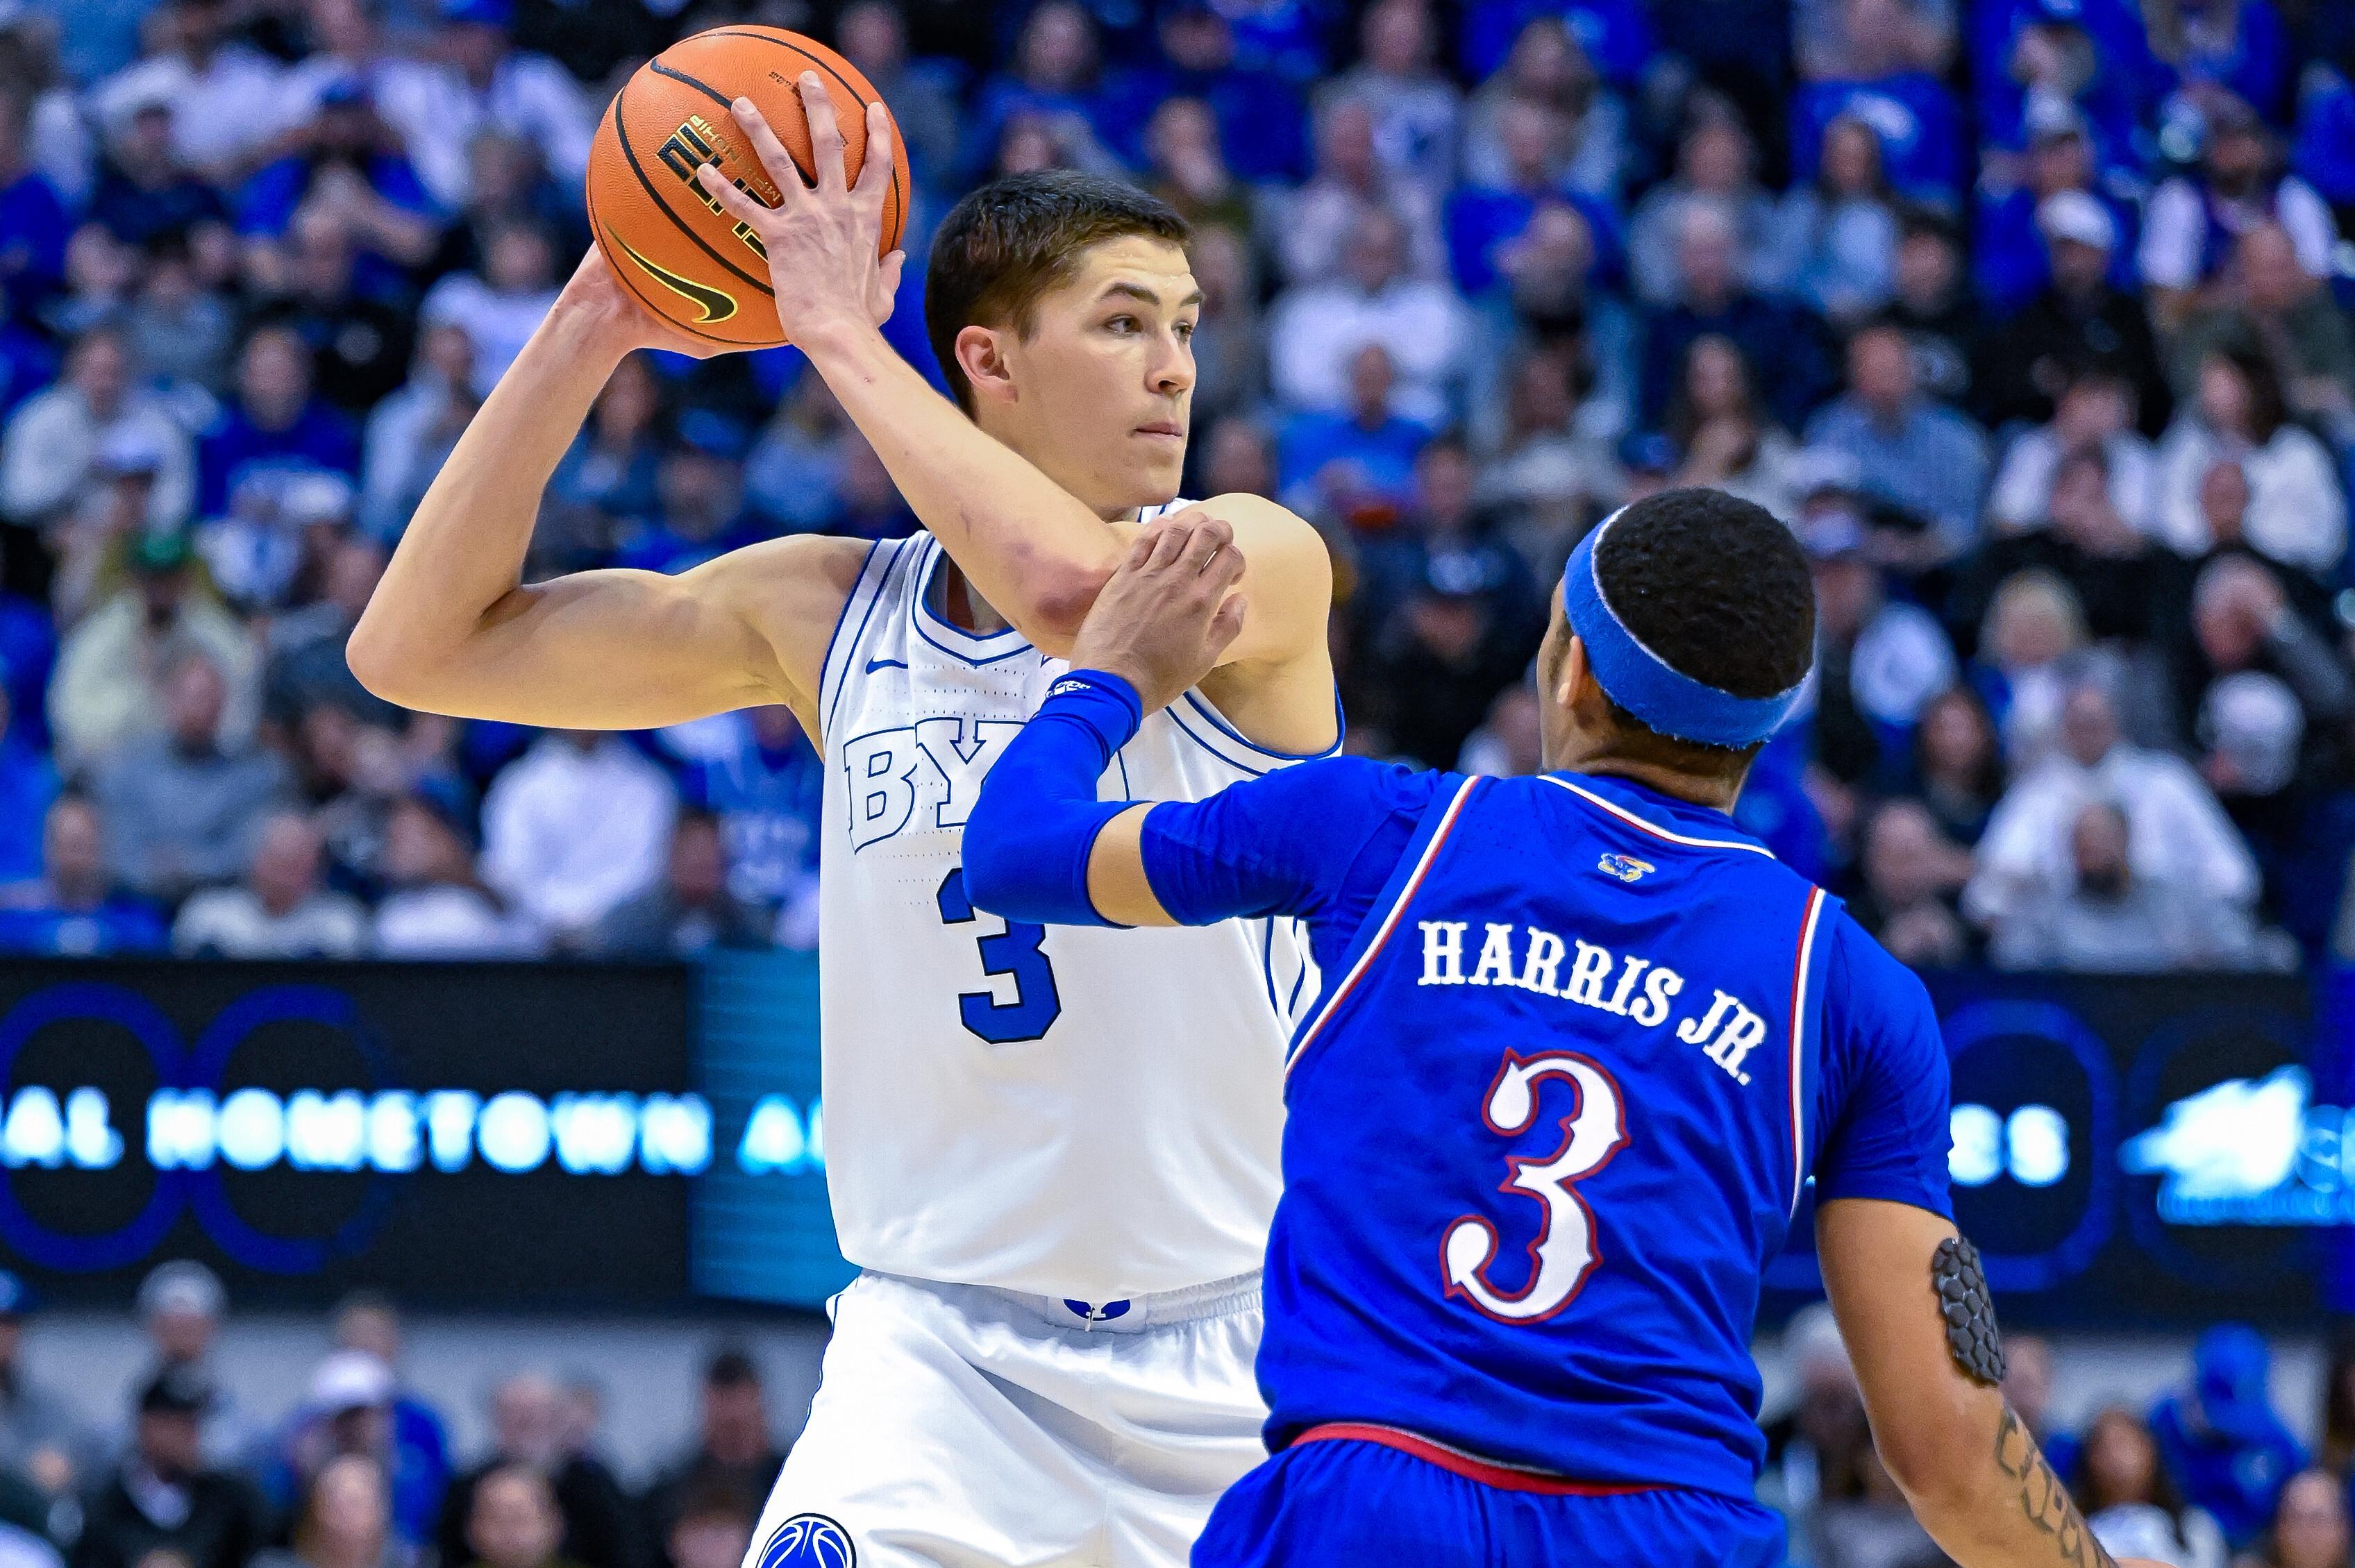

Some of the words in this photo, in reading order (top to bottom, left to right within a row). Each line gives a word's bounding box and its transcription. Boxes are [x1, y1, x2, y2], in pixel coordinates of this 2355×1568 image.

[843, 717, 1130, 854] BY
[936, 867, 1062, 1045] 3
[1418, 920, 1684, 1027] HARRIS
[1675, 988, 1768, 1086] JR.
[146, 1086, 715, 1175] HOMETOWN
[1439, 1046, 1632, 1326] 3
